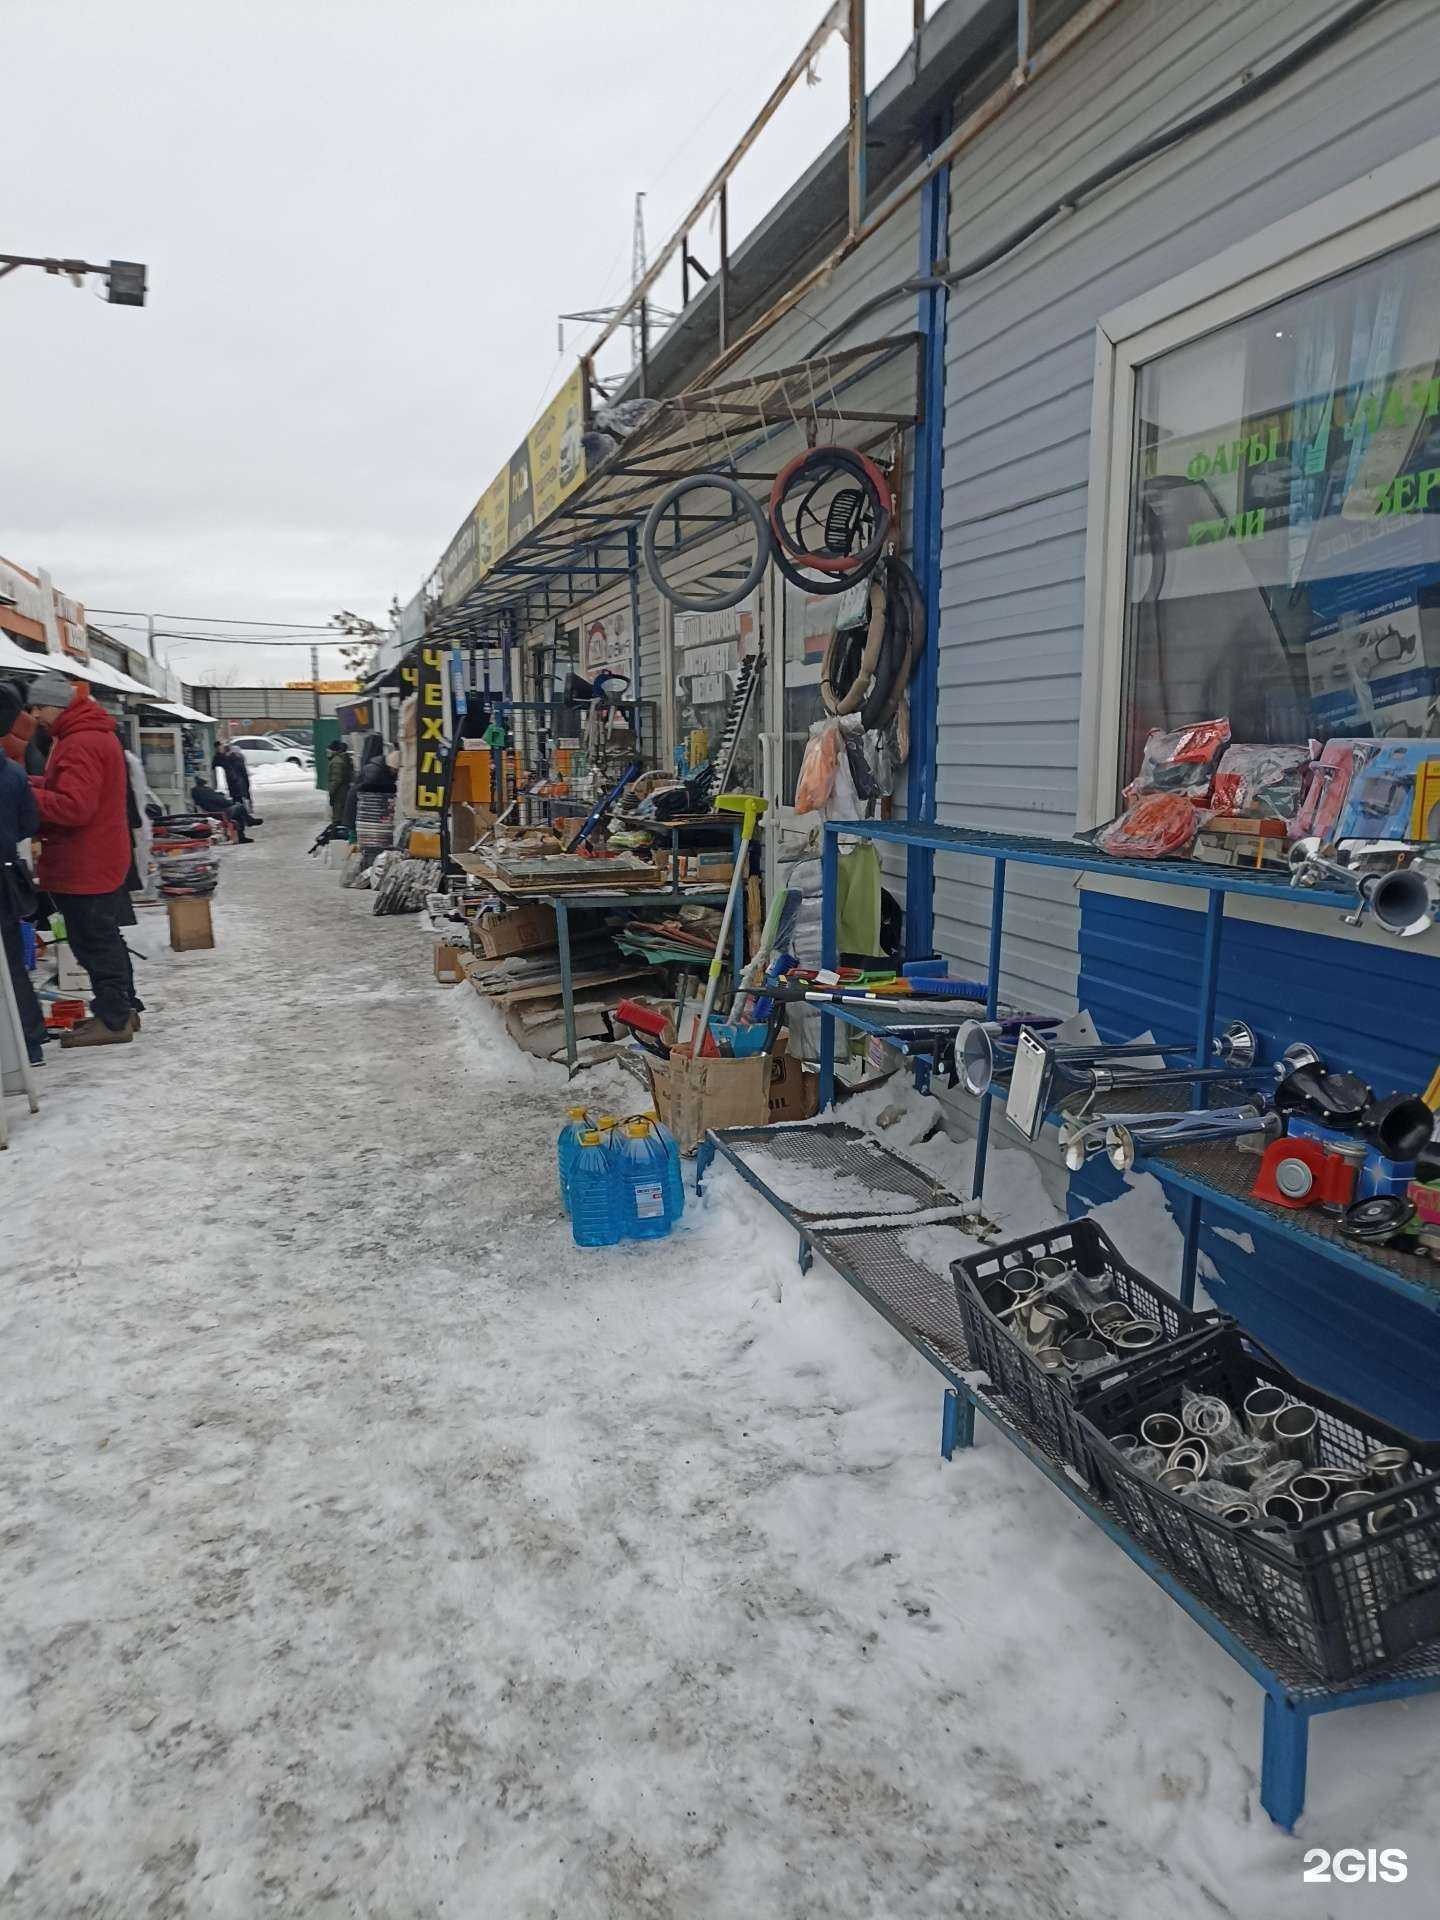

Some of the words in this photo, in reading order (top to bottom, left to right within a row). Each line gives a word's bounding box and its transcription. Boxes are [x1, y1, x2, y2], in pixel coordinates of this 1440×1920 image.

[1187, 427, 1281, 481] ФАРЫ
[1375, 467, 1440, 518] ЗЕР
[418, 648, 445, 807] ЧЕХЛЫ
